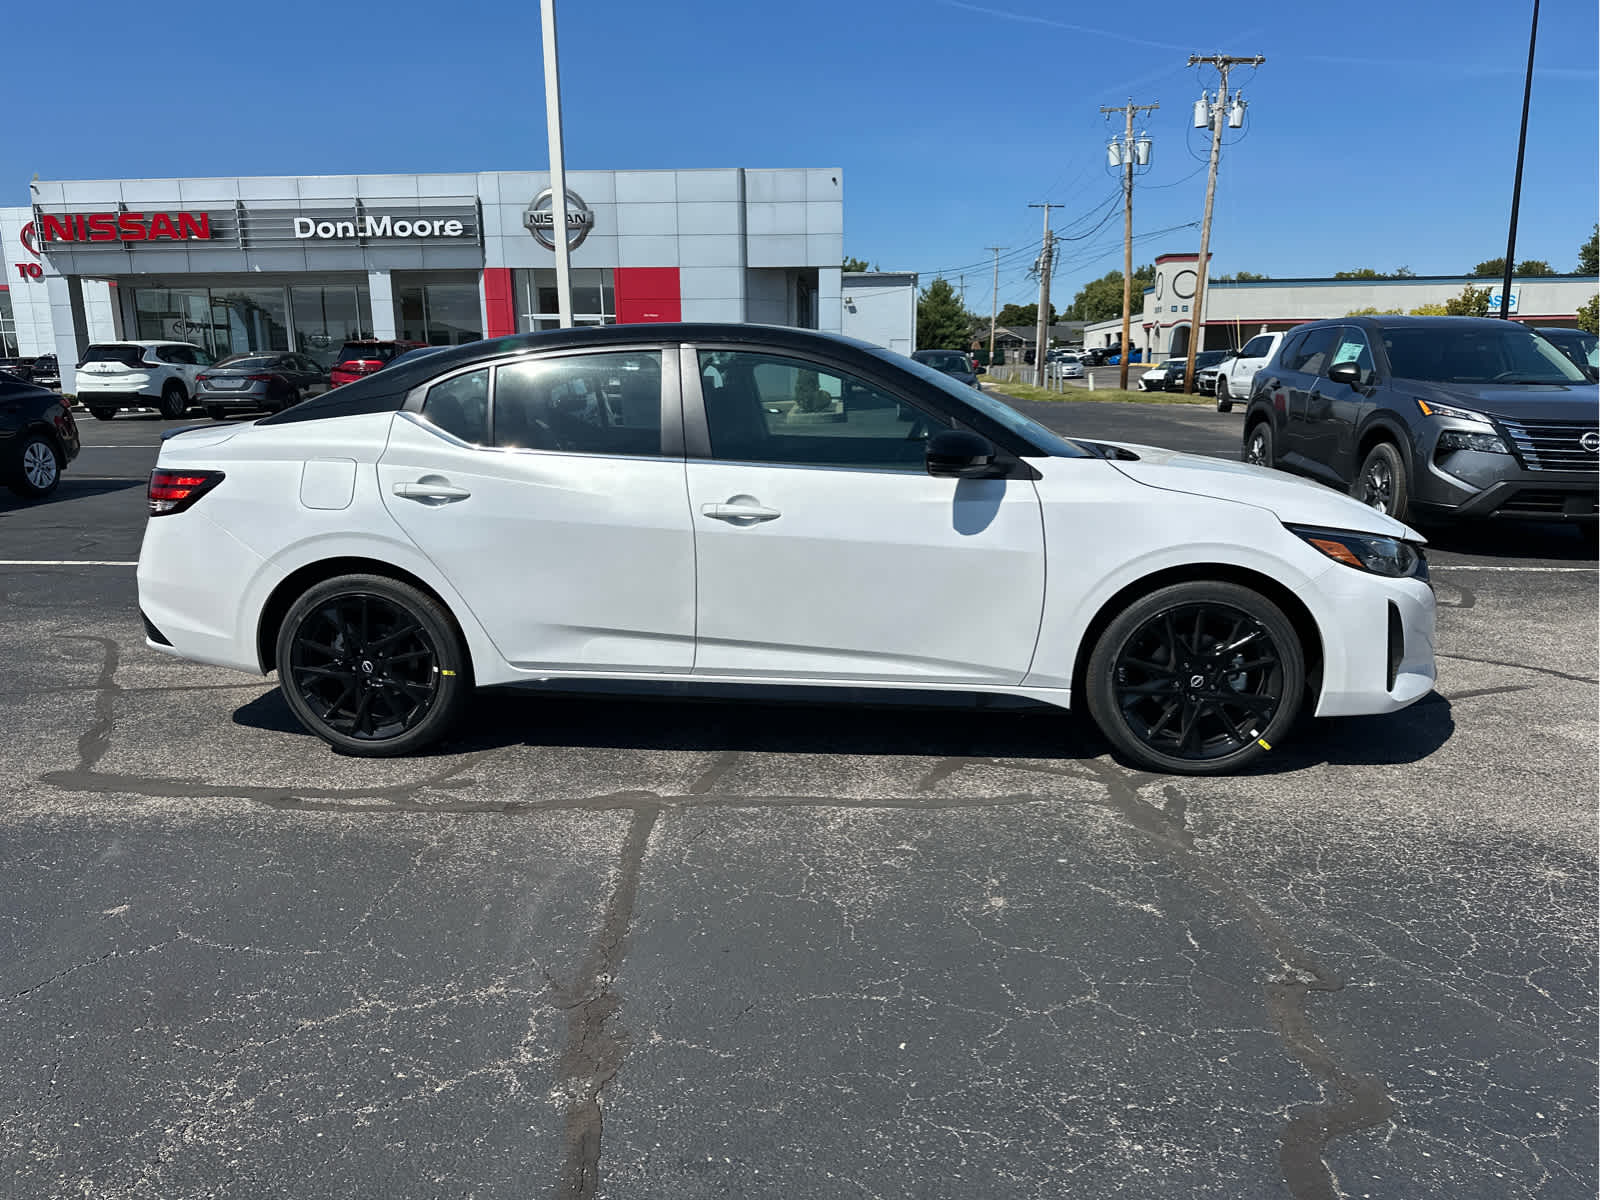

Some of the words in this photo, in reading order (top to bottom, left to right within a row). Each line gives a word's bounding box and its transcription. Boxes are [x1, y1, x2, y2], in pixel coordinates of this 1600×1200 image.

[43, 213, 211, 241] NISSAN
[294, 217, 355, 239] Don
[364, 215, 464, 238] Moore
[529, 213, 586, 224] NISAN
[15, 262, 43, 279] TO
